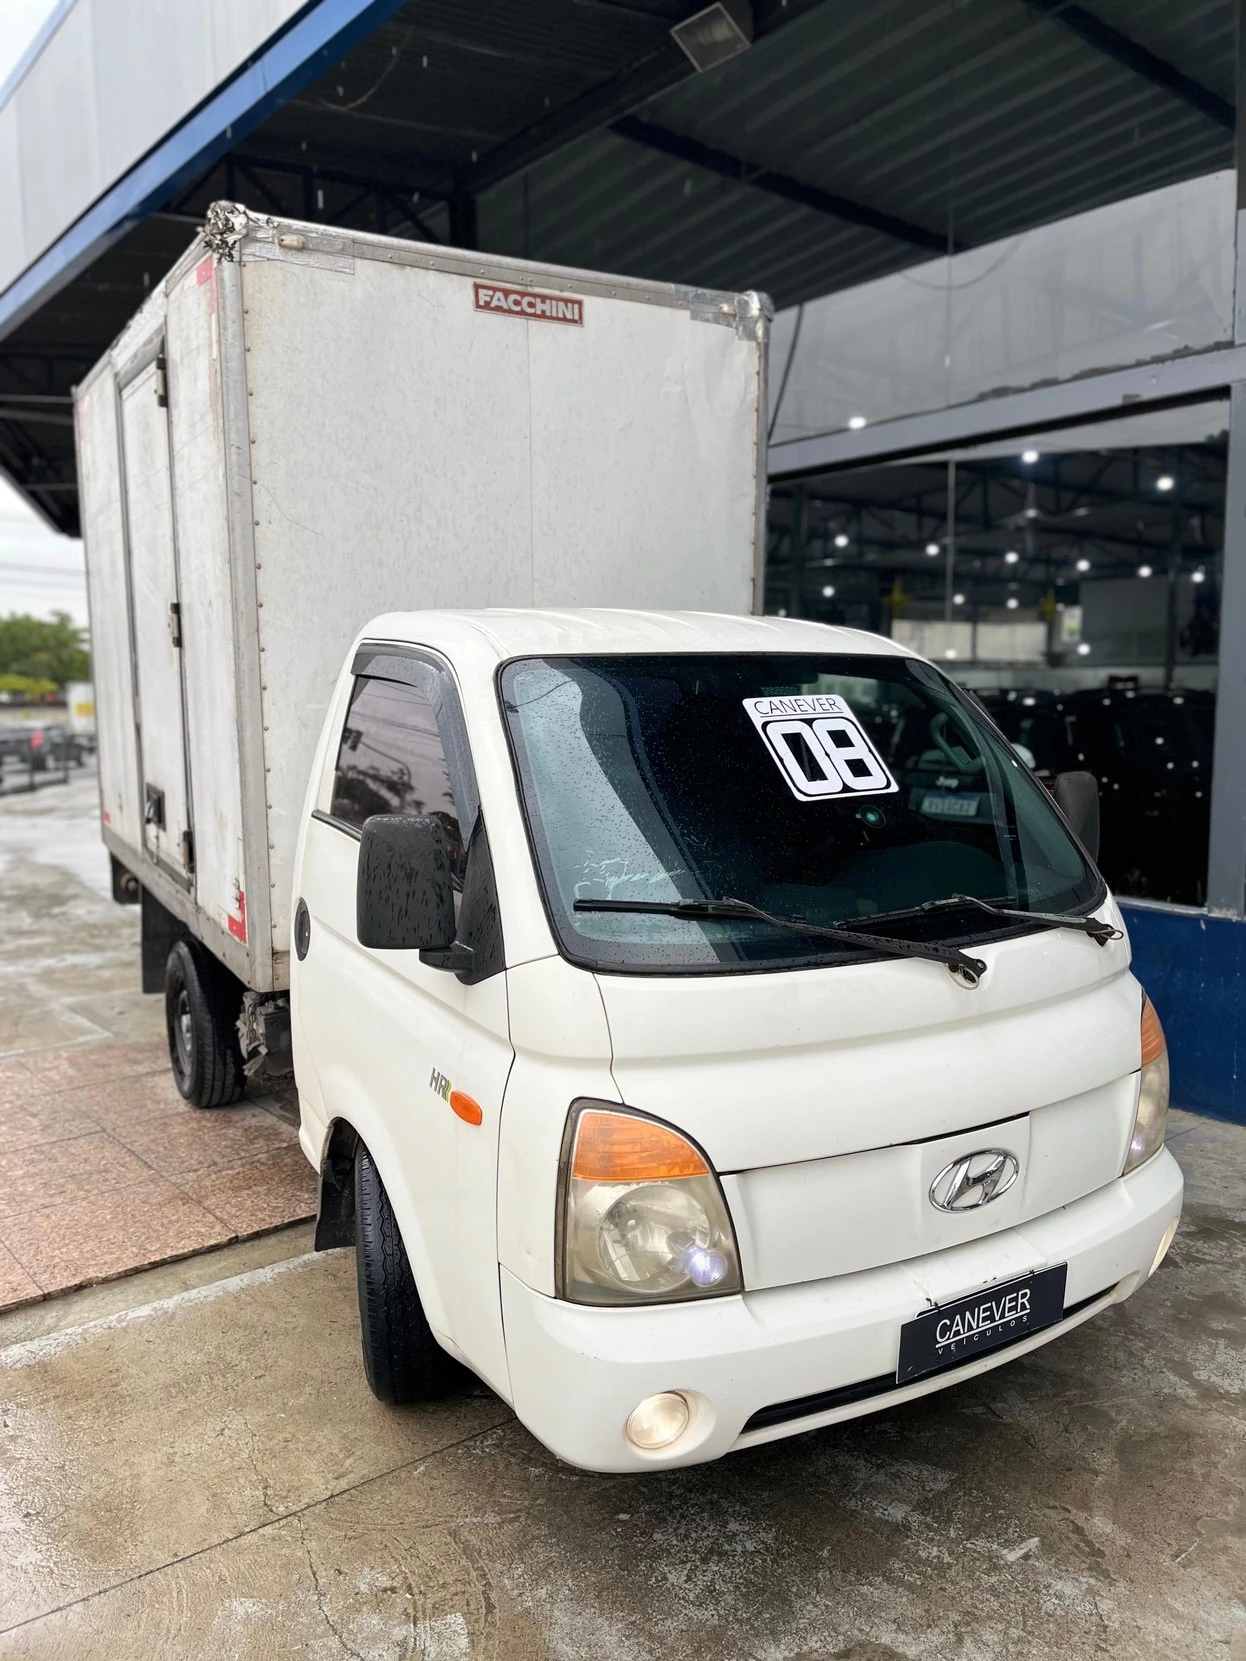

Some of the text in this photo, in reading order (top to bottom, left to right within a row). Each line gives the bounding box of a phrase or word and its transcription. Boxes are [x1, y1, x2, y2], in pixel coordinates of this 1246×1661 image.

[477, 288, 580, 320] FACCHINI
[754, 697, 843, 716] CANEVER
[766, 719, 888, 795] 08
[936, 1288, 1031, 1343] CANEVER
[938, 1315, 1028, 1355] VEICULOS
